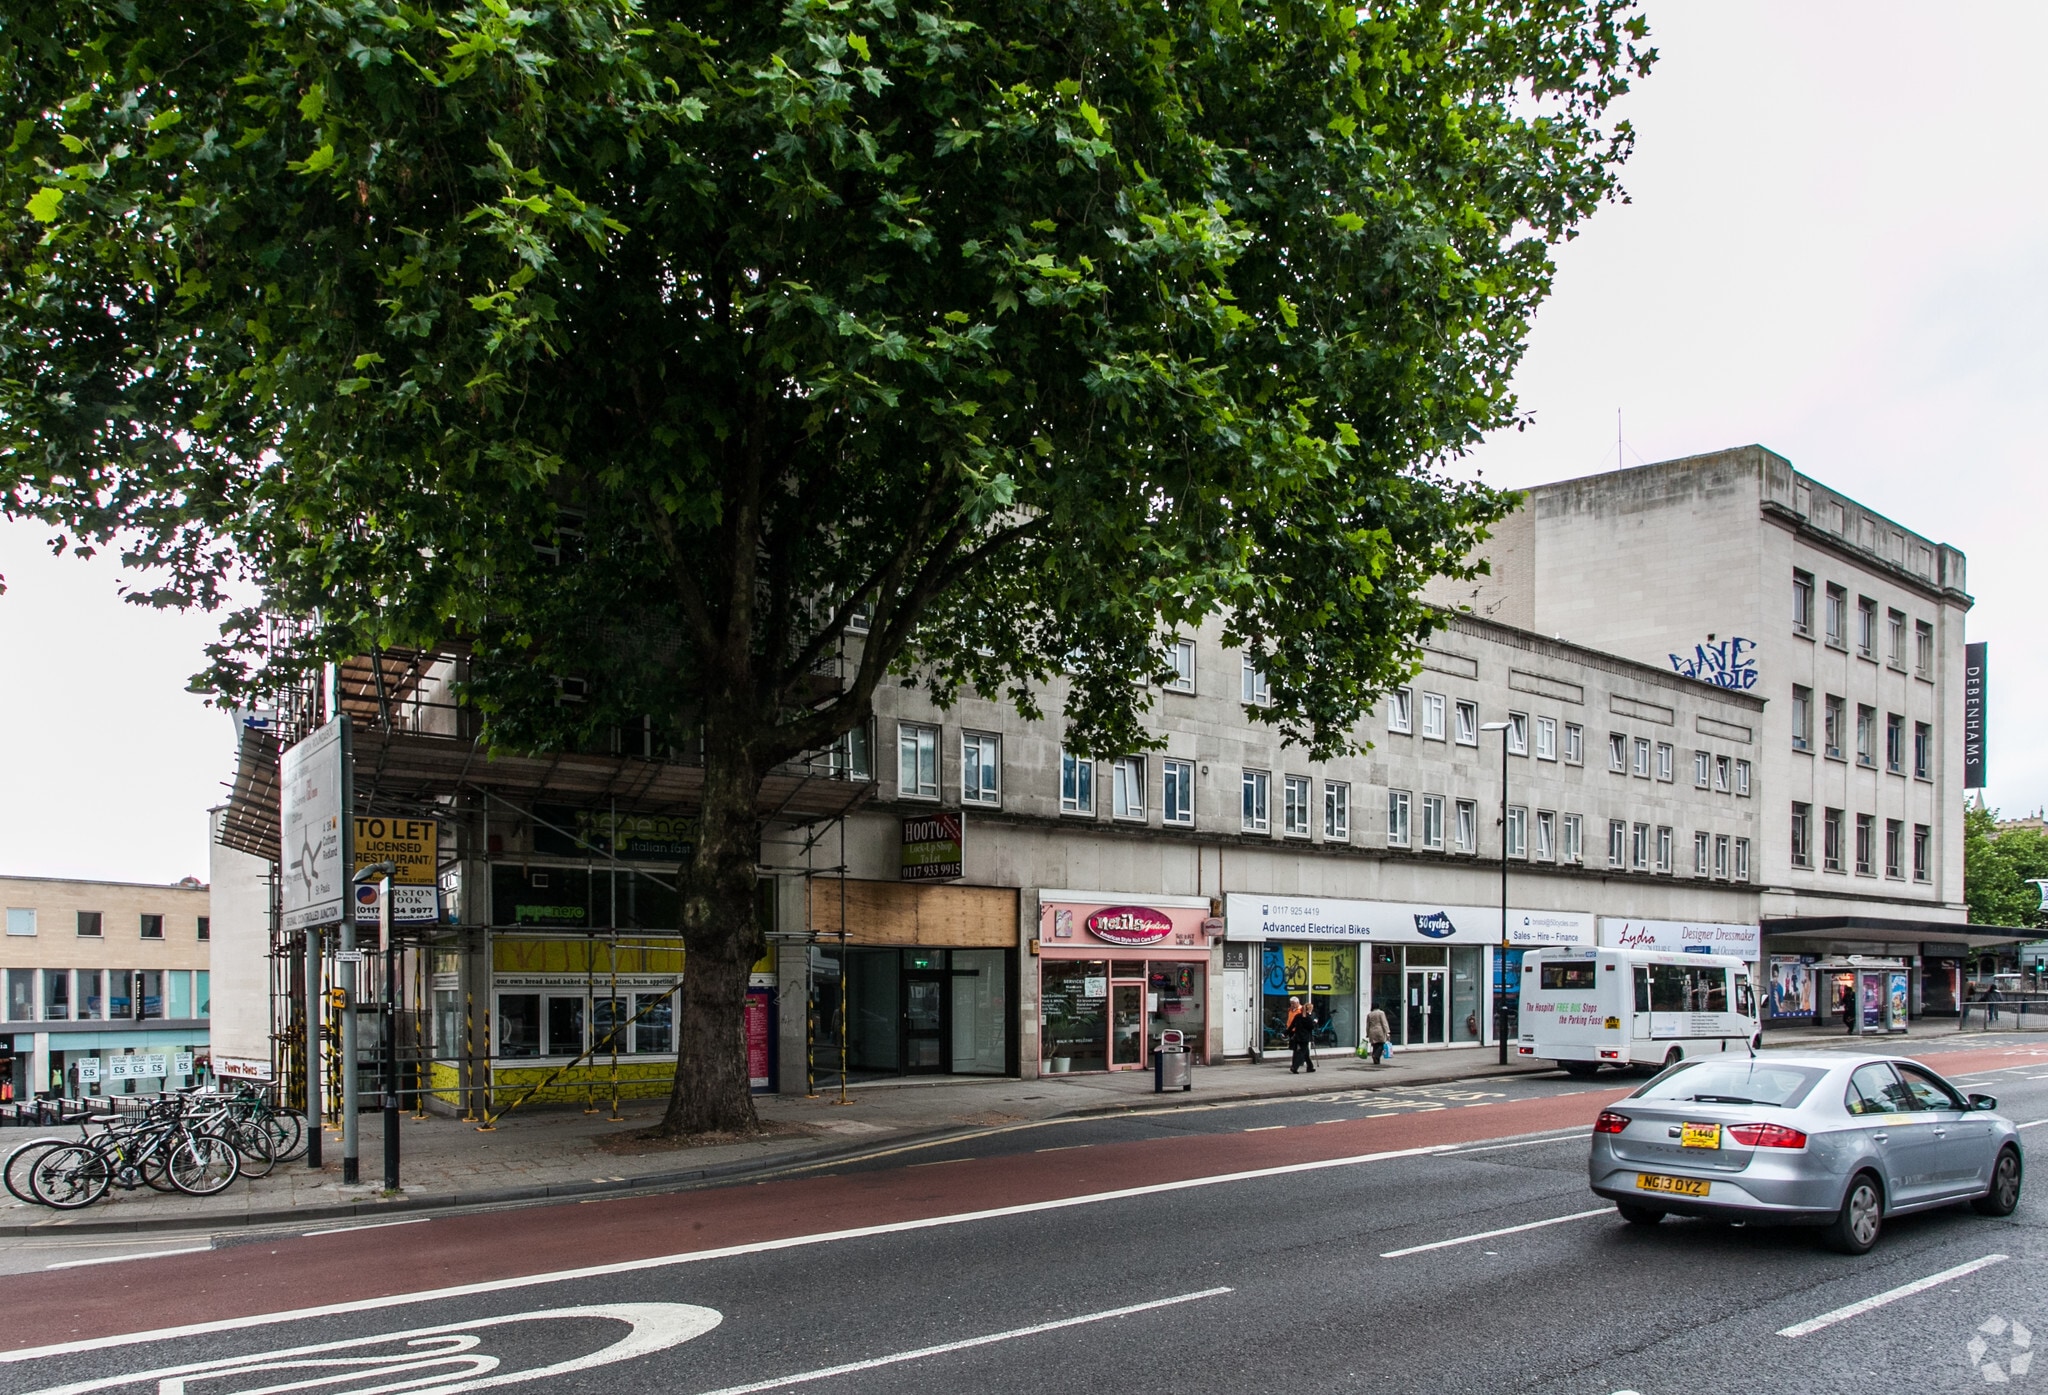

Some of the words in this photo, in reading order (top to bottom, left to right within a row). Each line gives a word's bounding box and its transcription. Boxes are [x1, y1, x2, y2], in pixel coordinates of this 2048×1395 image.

[1966, 666, 1980, 765] DEBENHAMS
[354, 818, 386, 839] TO
[392, 820, 434, 841] LET
[366, 841, 422, 853] LICENSED
[631, 842, 668, 853] italian
[671, 843, 691, 854] fast
[936, 841, 953, 853] Shop
[355, 853, 433, 865] RESTAURANT/
[920, 854, 929, 864] To
[930, 853, 941, 863] Let
[903, 866, 922, 878] 0117
[923, 864, 939, 876] 933
[940, 863, 961, 875] 9915
[319, 904, 338, 919] JUNCTION
[410, 906, 434, 914] 9977
[515, 904, 585, 923] pepenero
[1272, 905, 1288, 914] 0117
[1290, 906, 1303, 916] 925
[1304, 907, 1320, 916] 4419
[1097, 914, 1145, 931] nails
[1262, 921, 1306, 933] Advanced
[1308, 923, 1346, 934] Electrical
[1348, 924, 1371, 935] Bikes
[1100, 931, 1121, 941] American
[1151, 933, 1163, 941] Salon
[1513, 930, 1531, 940] Sales
[1537, 932, 1549, 941] Hire
[1556, 932, 1578, 942] Finance
[1618, 922, 1656, 949] Lydia
[1681, 926, 1714, 943] Designer
[1715, 928, 1755, 941] Dressmaker
[1238, 952, 1243, 961] 8
[1720, 946, 1743, 956] Occasion
[593, 978, 602, 986] the
[650, 979, 675, 988] appetito!
[1526, 1002, 1534, 1011] The
[1534, 1002, 1556, 1013] Hospital
[1556, 1003, 1570, 1012] FREE
[1570, 1003, 1581, 1012] BUS
[1582, 1003, 1597, 1014] Stops
[1559, 1015, 1567, 1024] the
[1567, 1015, 1587, 1026] Parking
[1588, 1015, 1604, 1025] Fuss!
[152, 1064, 162, 1072] £5
[179, 1062, 188, 1070] £5
[84, 1069, 95, 1077] £5
[1692, 1129, 1714, 1138] 1440
[1643, 1175, 1673, 1189] NG13
[1674, 1179, 1703, 1193] OYZ
